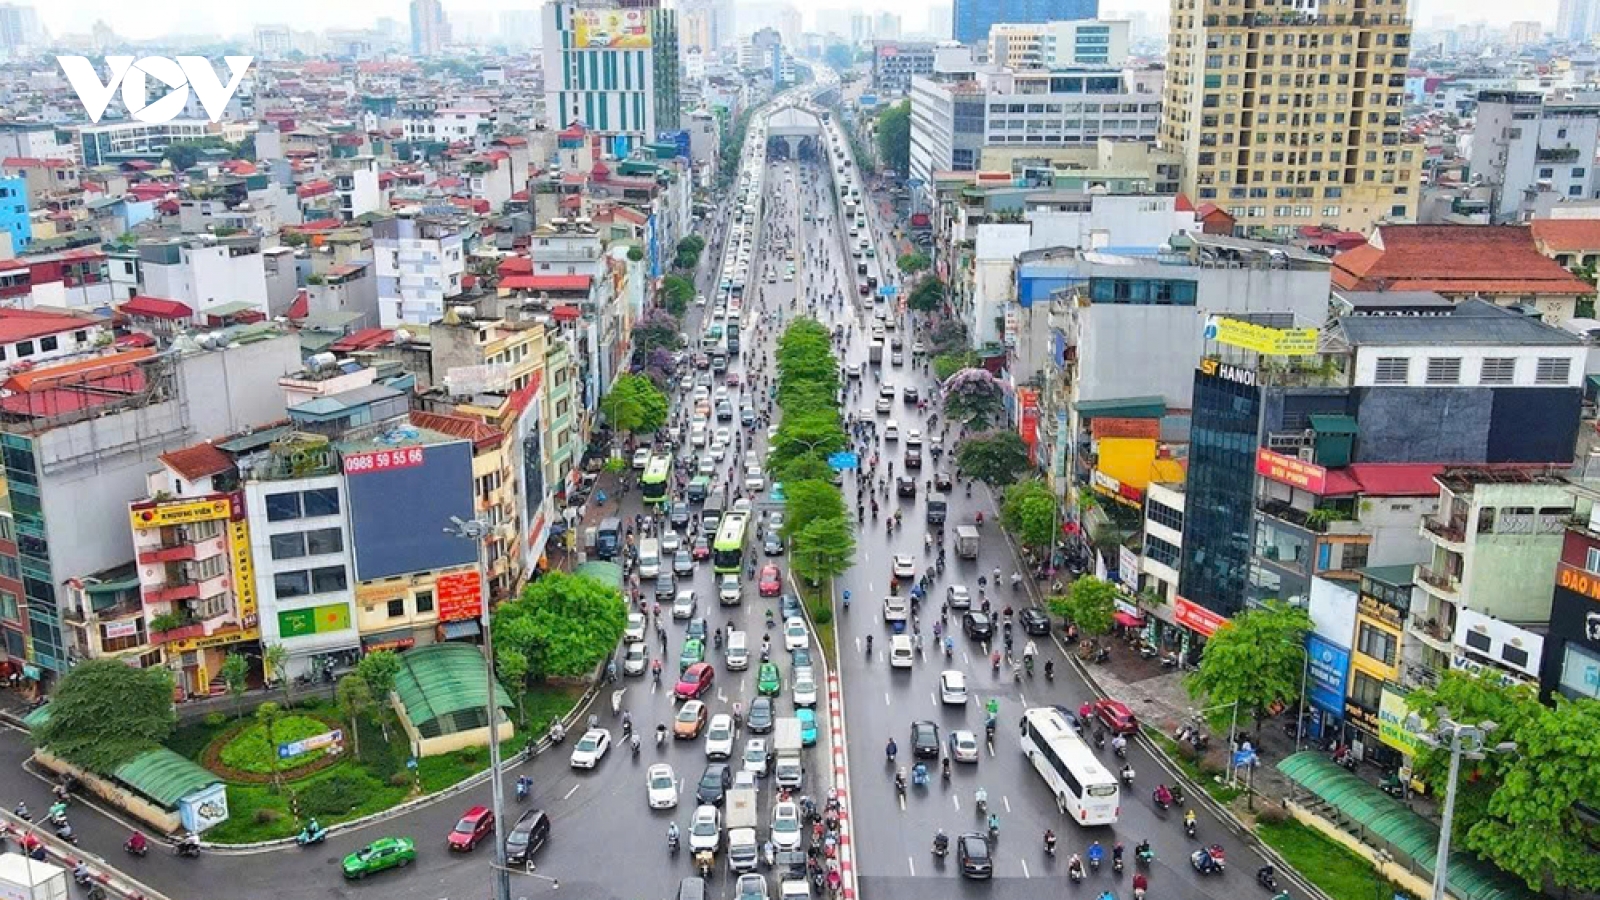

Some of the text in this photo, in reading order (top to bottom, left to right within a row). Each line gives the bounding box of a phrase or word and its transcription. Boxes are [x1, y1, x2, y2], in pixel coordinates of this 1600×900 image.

[1220, 364, 1256, 387] HANOI
[346, 455, 373, 471] 0988
[376, 453, 390, 467] 59
